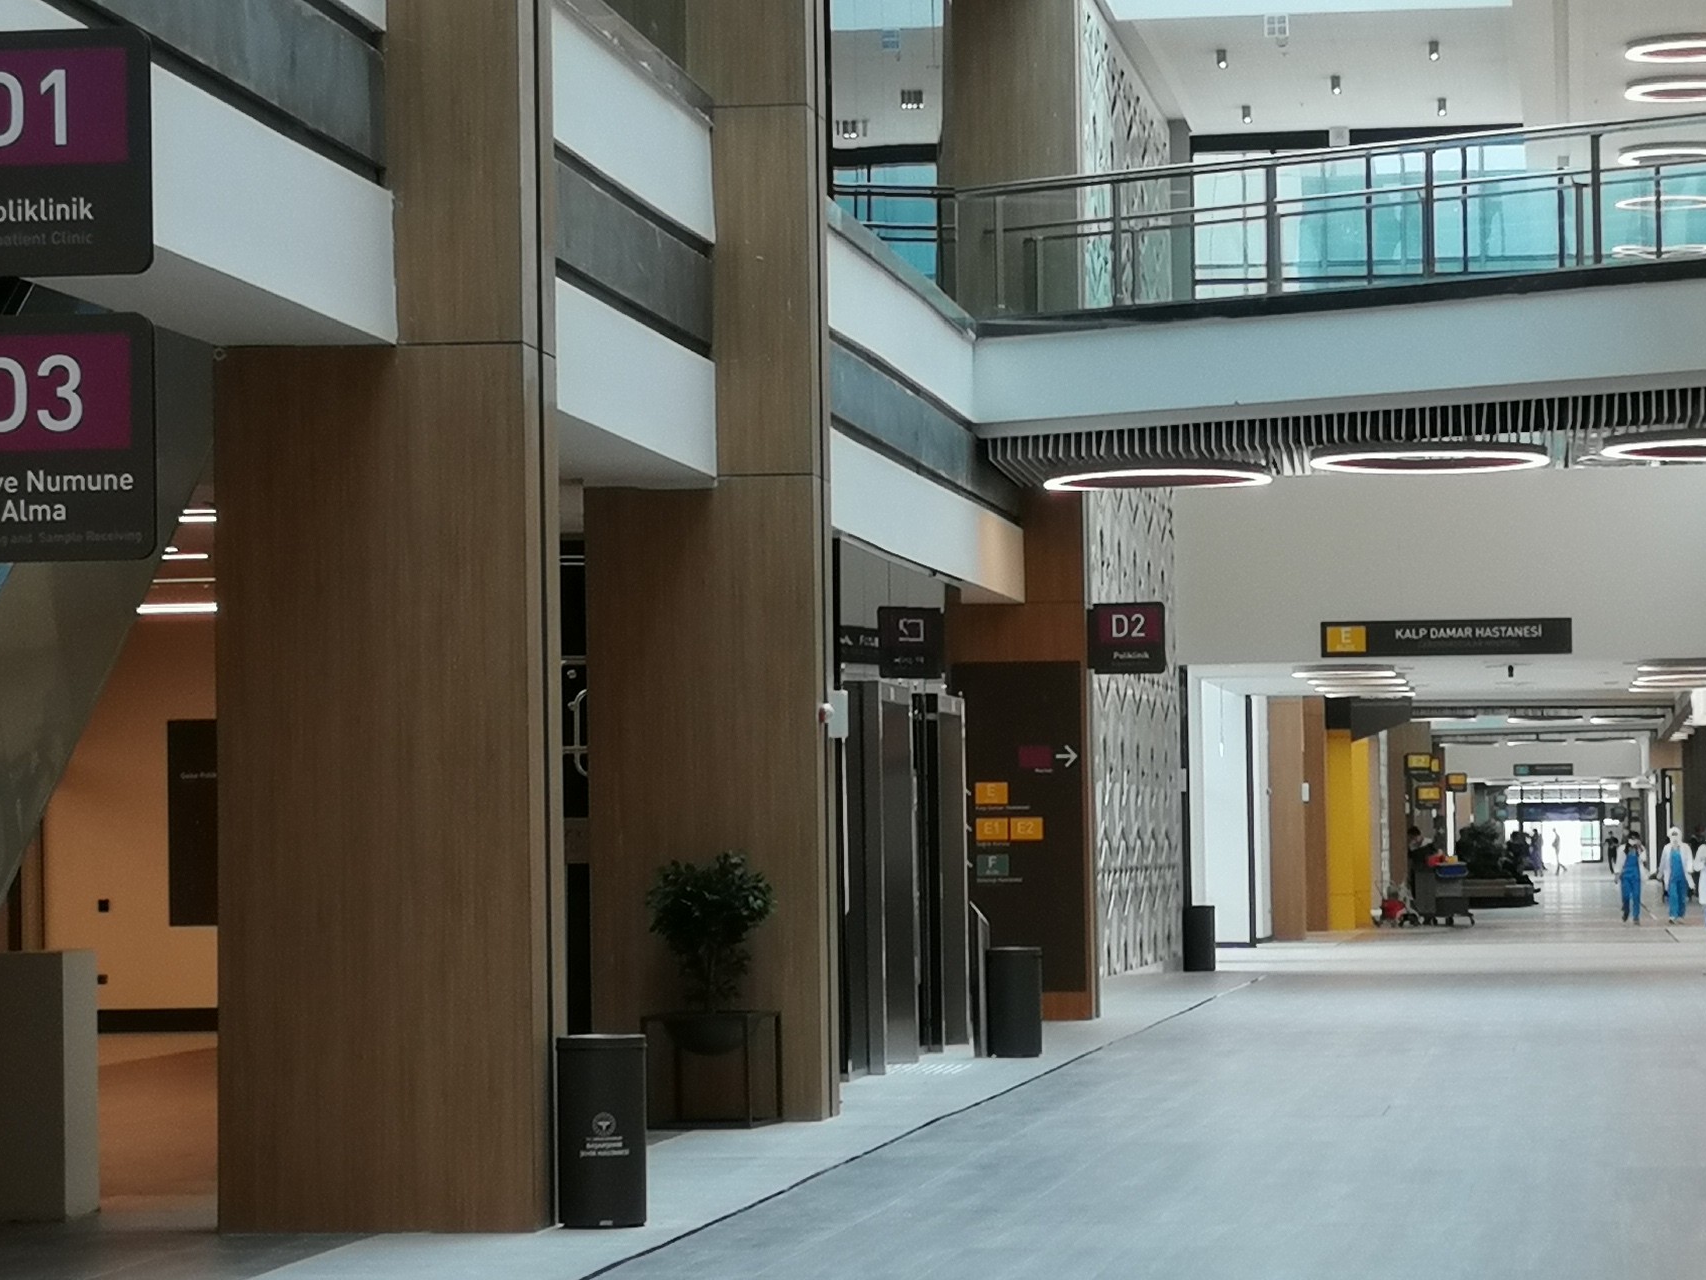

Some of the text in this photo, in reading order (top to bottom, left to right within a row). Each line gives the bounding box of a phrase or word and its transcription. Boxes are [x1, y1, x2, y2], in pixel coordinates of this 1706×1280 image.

[51, 230, 94, 246] Clinic
[26, 469, 134, 493] Numune
[0, 499, 67, 522] Alma
[1111, 613, 1146, 638] D2
[1395, 623, 1543, 640] KALP DAMAR HASTANESİ
[1341, 626, 1352, 644] E
[1017, 821, 1036, 835] E2
